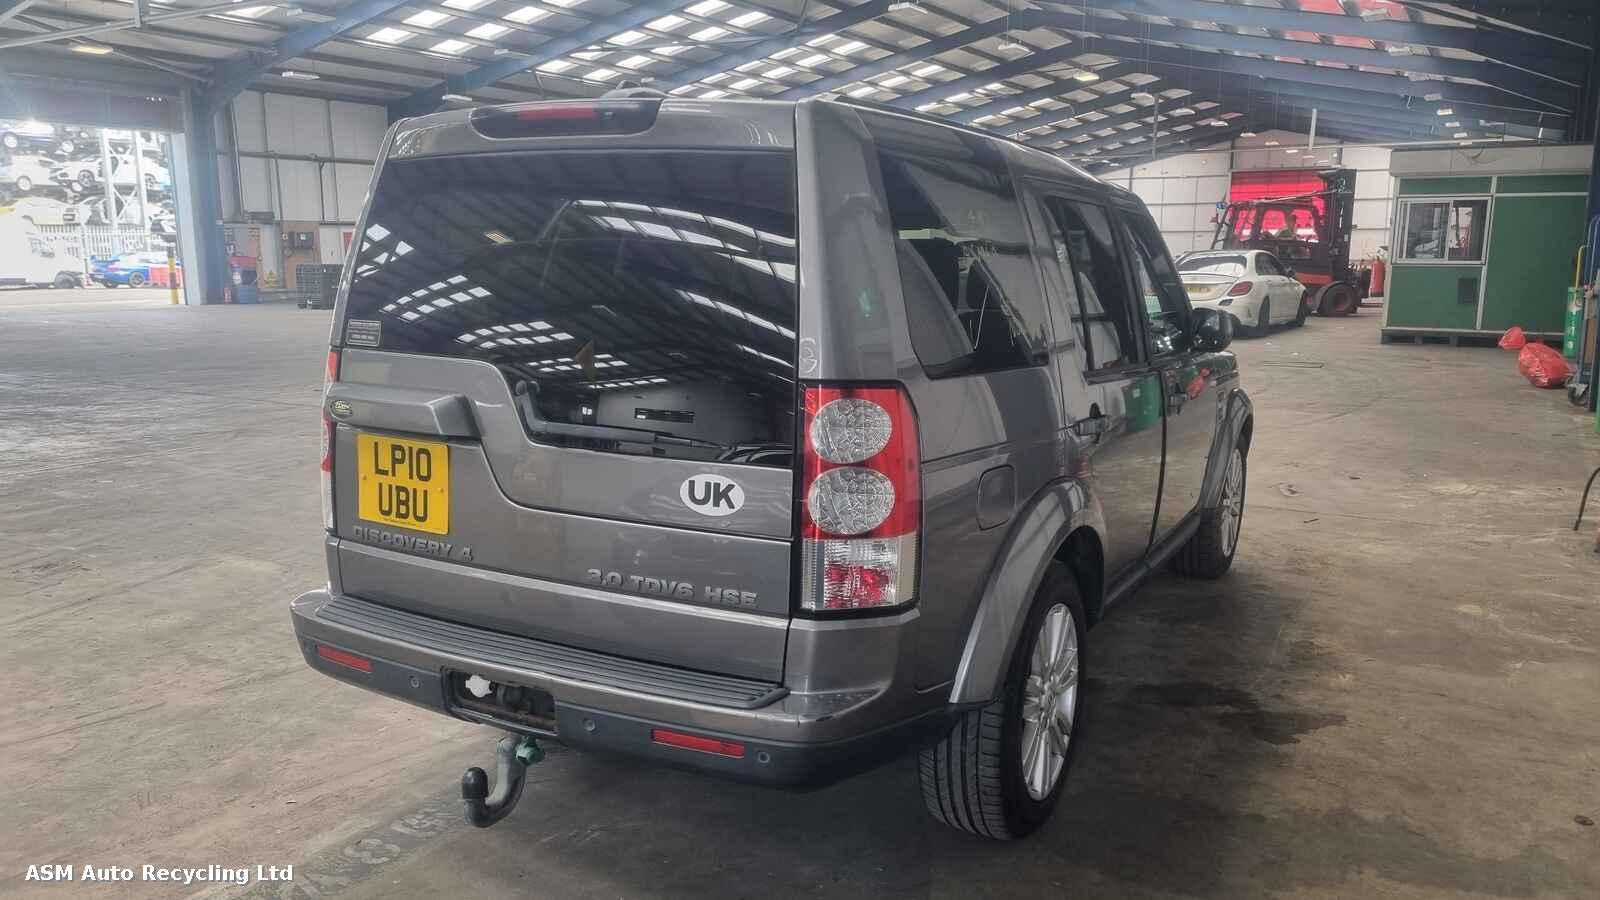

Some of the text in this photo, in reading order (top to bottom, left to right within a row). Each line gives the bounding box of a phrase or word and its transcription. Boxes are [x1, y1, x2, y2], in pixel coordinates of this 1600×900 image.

[374, 441, 432, 482] LP10
[378, 482, 428, 522] UBU
[688, 479, 735, 509] UK
[353, 525, 474, 561] DISCOVERY 4
[587, 568, 758, 607] 3.0 TDV6 HSE
